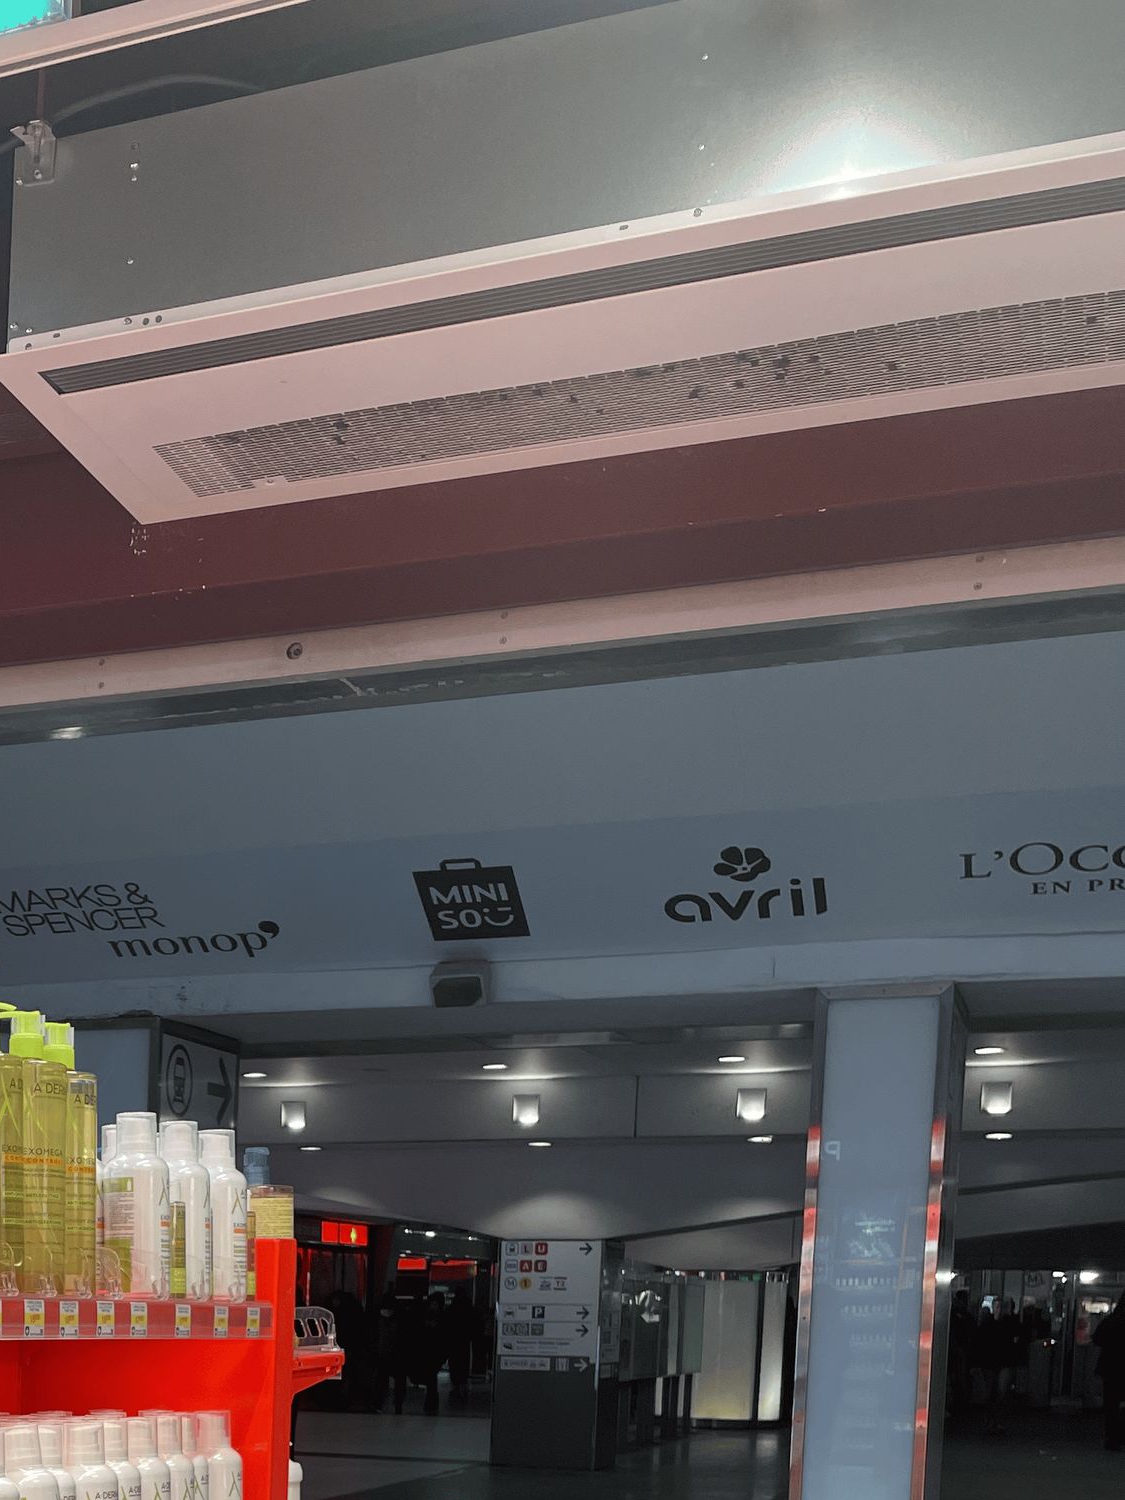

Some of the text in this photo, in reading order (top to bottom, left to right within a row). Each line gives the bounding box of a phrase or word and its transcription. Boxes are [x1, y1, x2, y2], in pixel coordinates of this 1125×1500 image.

[124, 882, 153, 904] &
[429, 883, 509, 904] MINI
[1031, 880, 1071, 895] EN
[665, 878, 827, 923] avril
[3, 907, 165, 936] SPENCER
